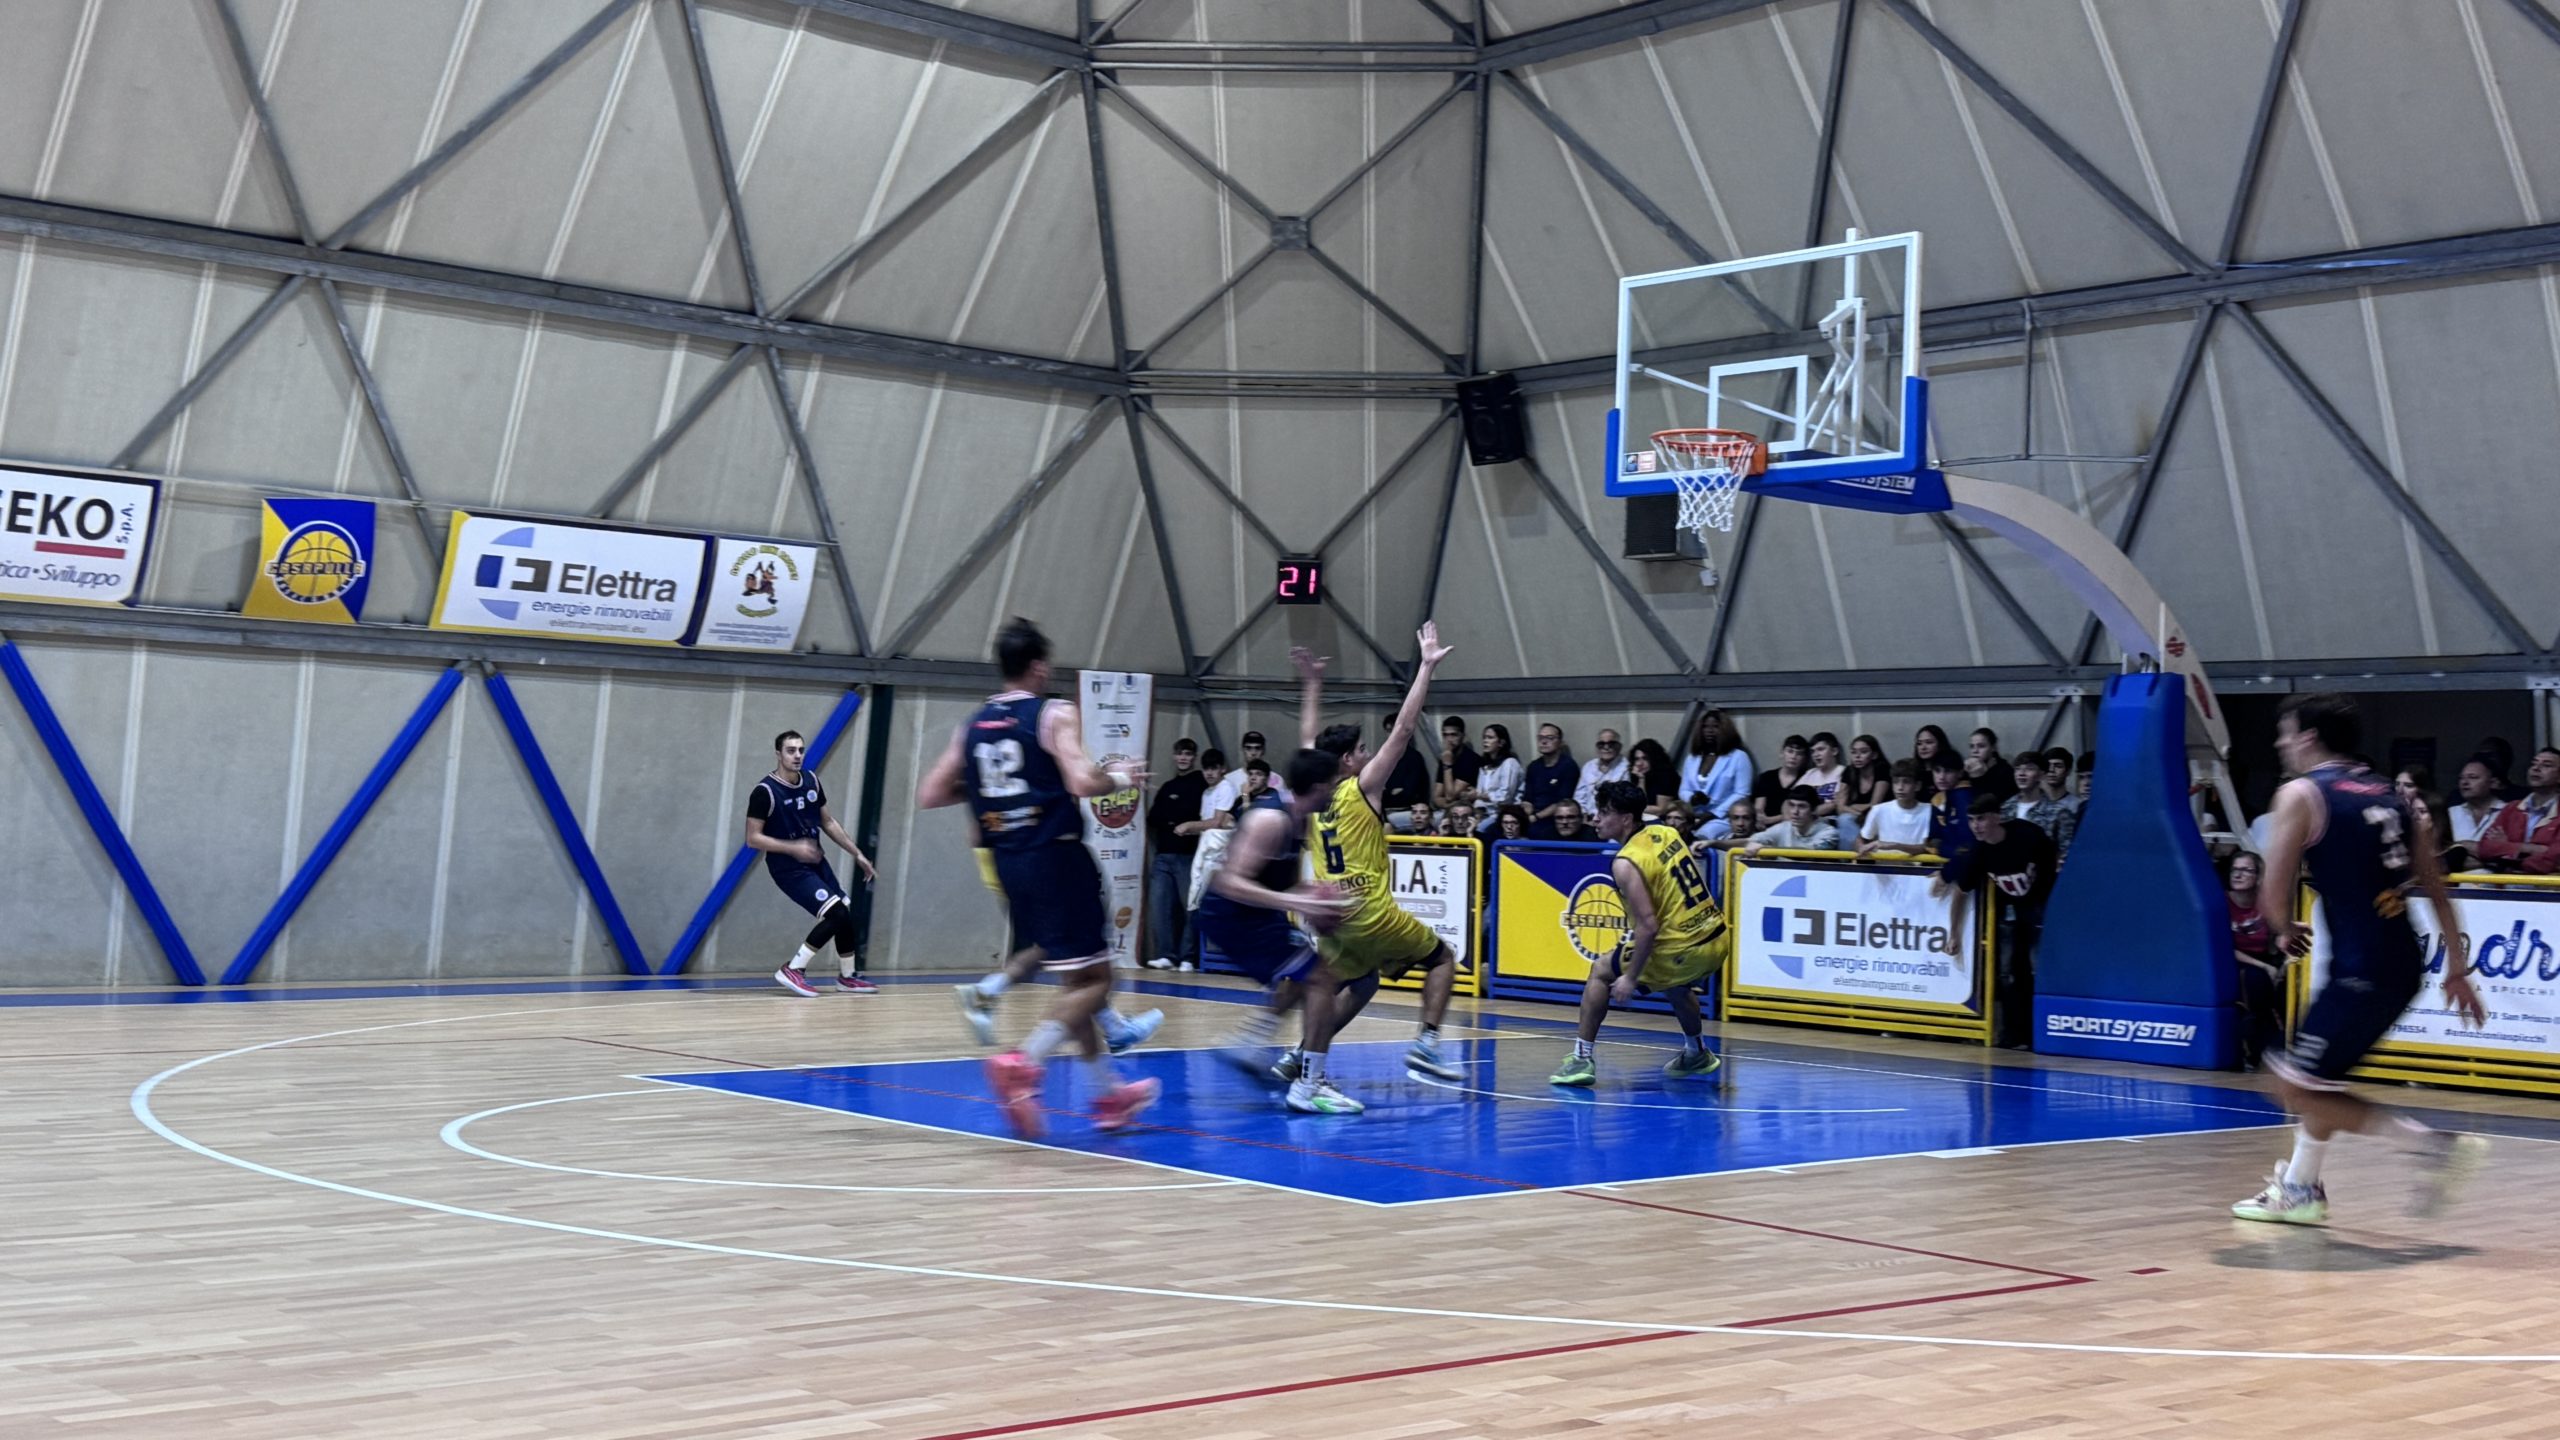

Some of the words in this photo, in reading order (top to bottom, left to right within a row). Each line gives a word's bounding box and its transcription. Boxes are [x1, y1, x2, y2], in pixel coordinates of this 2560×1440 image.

[0, 489, 114, 541] EKO
[38, 563, 121, 589] Sviluppo
[267, 561, 364, 576] CASAPULLA
[558, 562, 678, 603] Elettra
[1279, 566, 1316, 596] 21
[531, 601, 592, 618] energie
[594, 604, 673, 621] rinnovabili
[1321, 828, 1346, 875] 6
[1669, 855, 1710, 910] 19
[1561, 913, 1627, 929] CASAPULL
[1835, 911, 1948, 953] Elettra
[1814, 955, 1868, 973] energie
[1872, 957, 1949, 977] rinnovabili
[2046, 1014, 2198, 1042] SPORTSYSTEM
